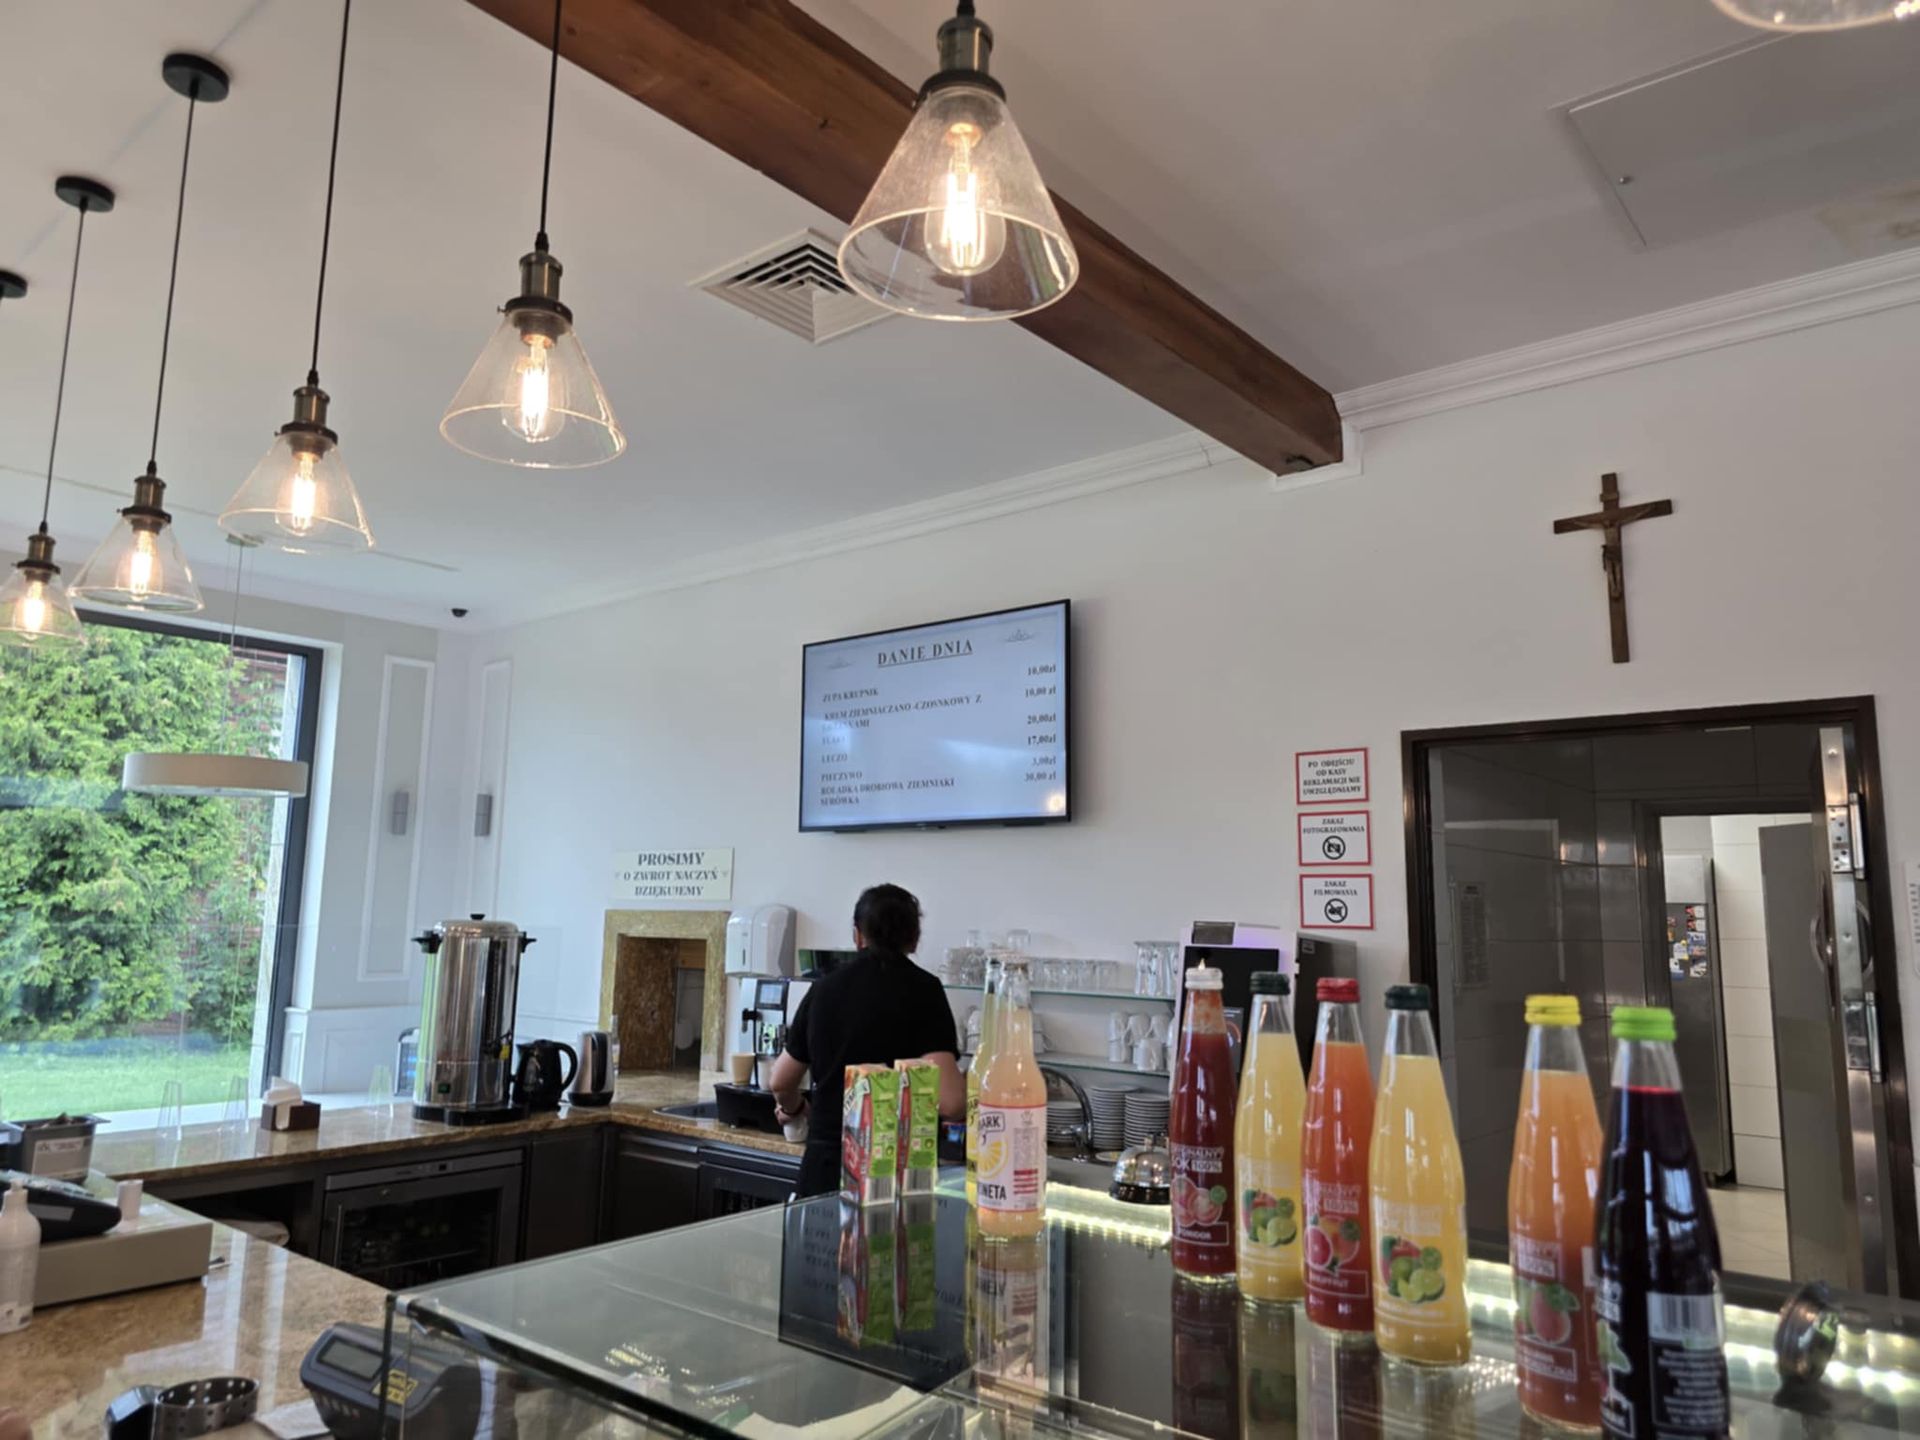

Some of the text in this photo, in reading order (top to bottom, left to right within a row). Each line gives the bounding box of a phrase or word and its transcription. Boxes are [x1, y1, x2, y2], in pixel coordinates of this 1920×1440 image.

[878, 640, 973, 665] DANIE DNIA
[638, 852, 705, 866] PROSIMY
[623, 872, 631, 881] O
[633, 871, 672, 881] ZWROT
